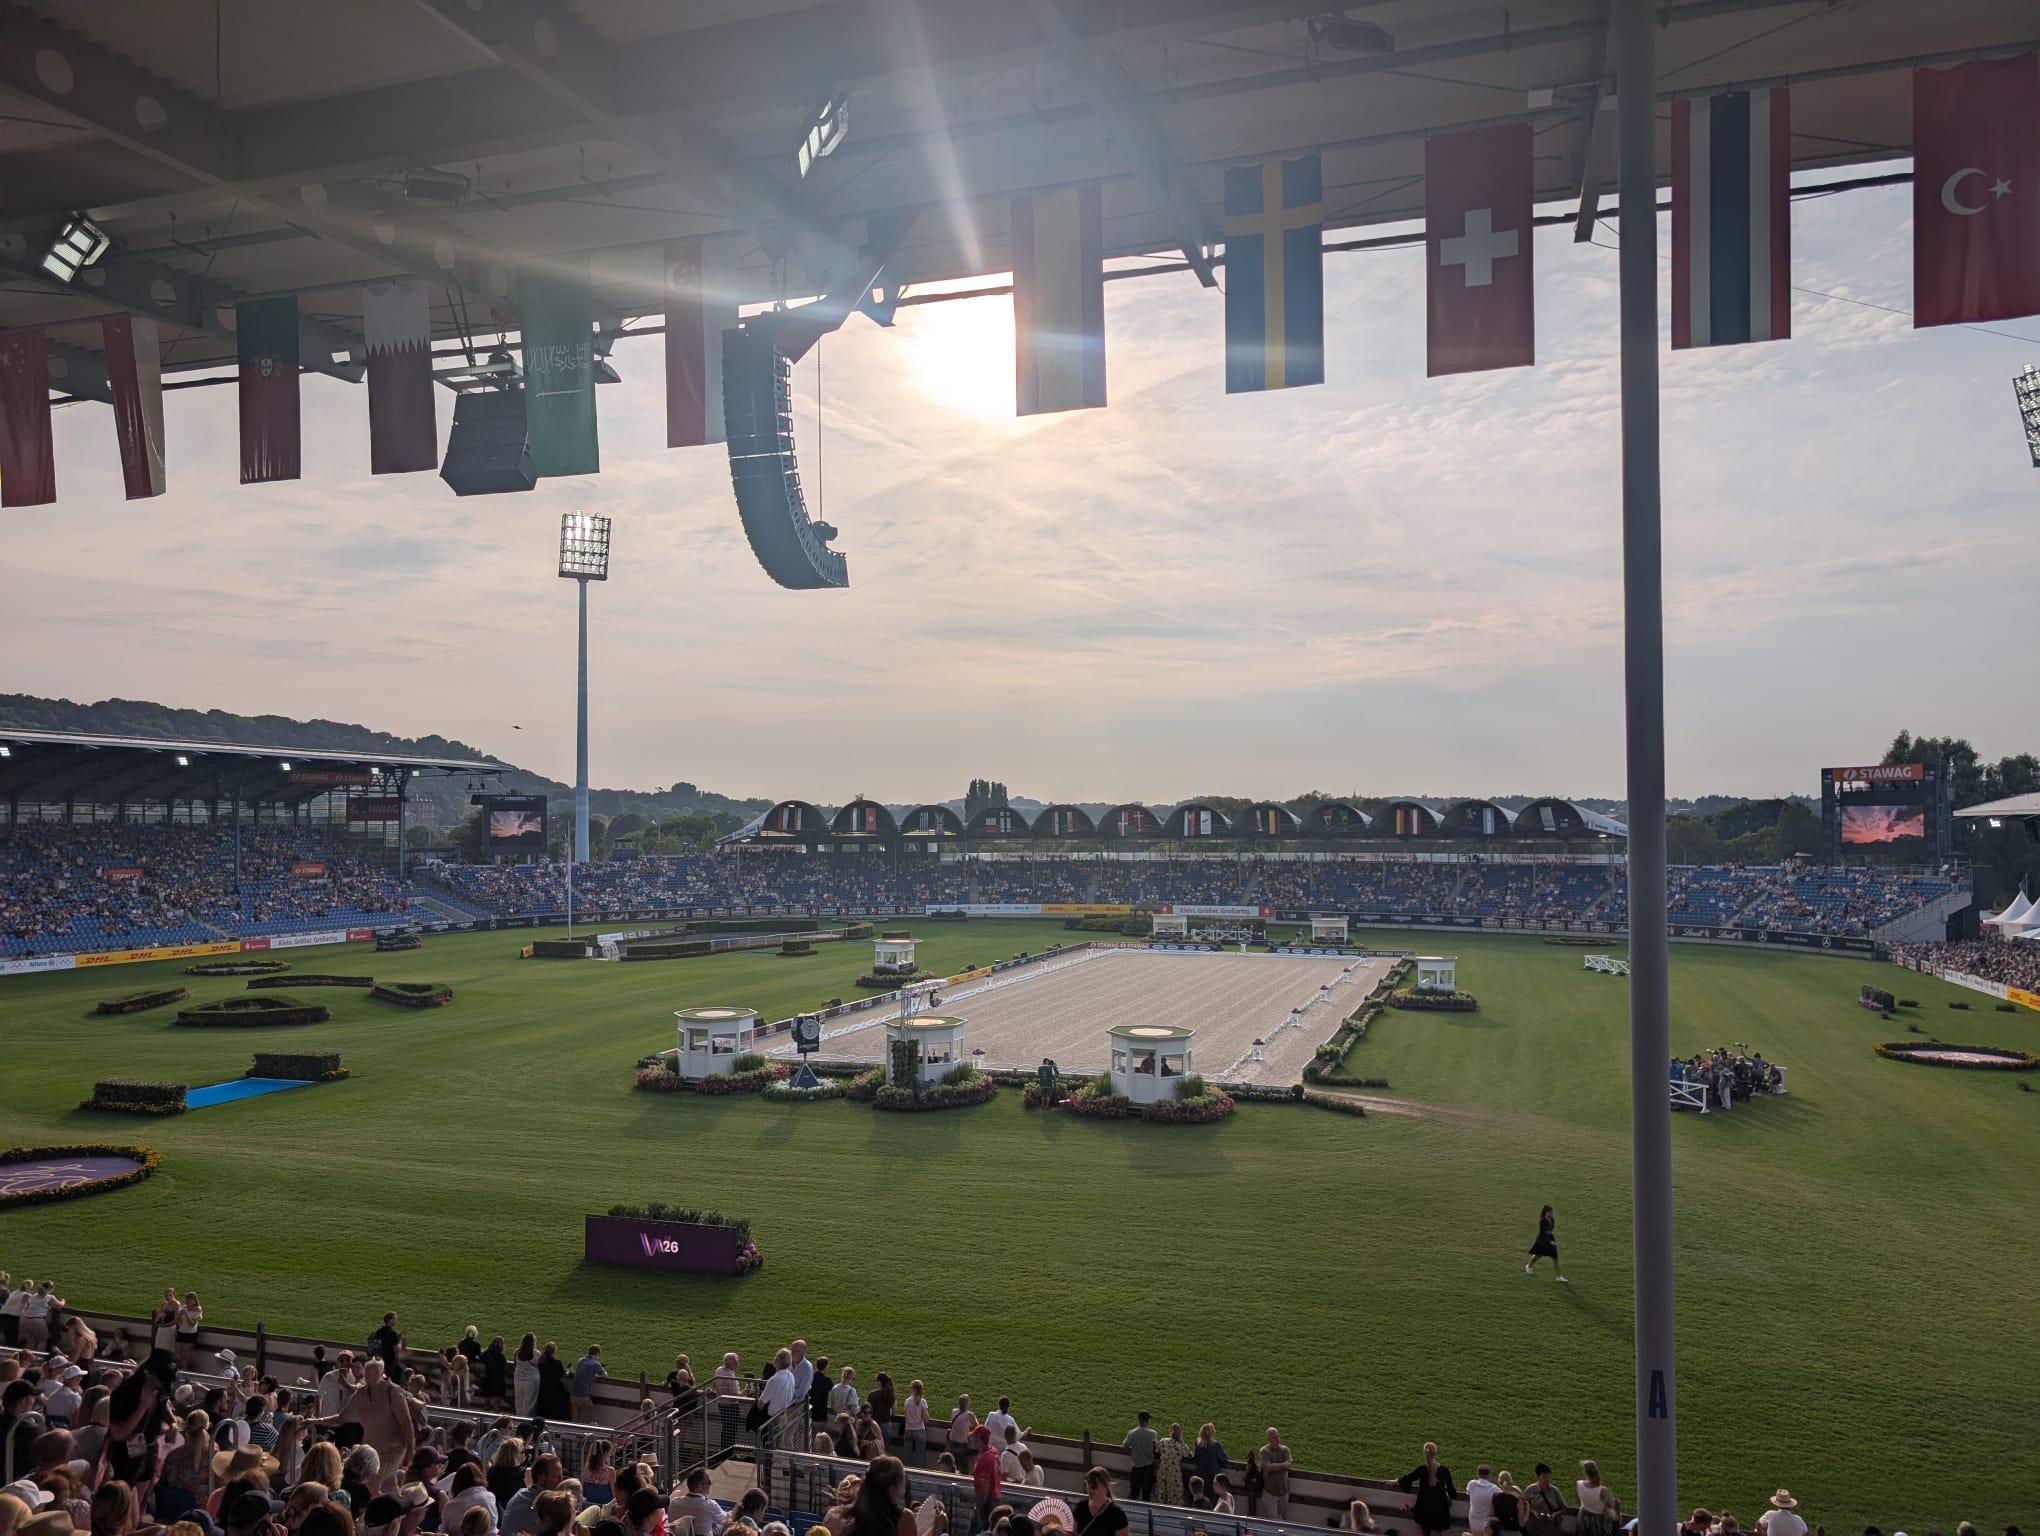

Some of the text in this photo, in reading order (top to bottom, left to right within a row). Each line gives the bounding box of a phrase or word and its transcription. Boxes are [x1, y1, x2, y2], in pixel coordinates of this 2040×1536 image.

[1859, 766, 1912, 779] STAWAG
[171, 948, 193, 956] DHL
[211, 944, 233, 952] DHL
[86, 955, 110, 964] DHL
[129, 951, 153, 960] DHL
[1647, 1369, 1669, 1420] A
